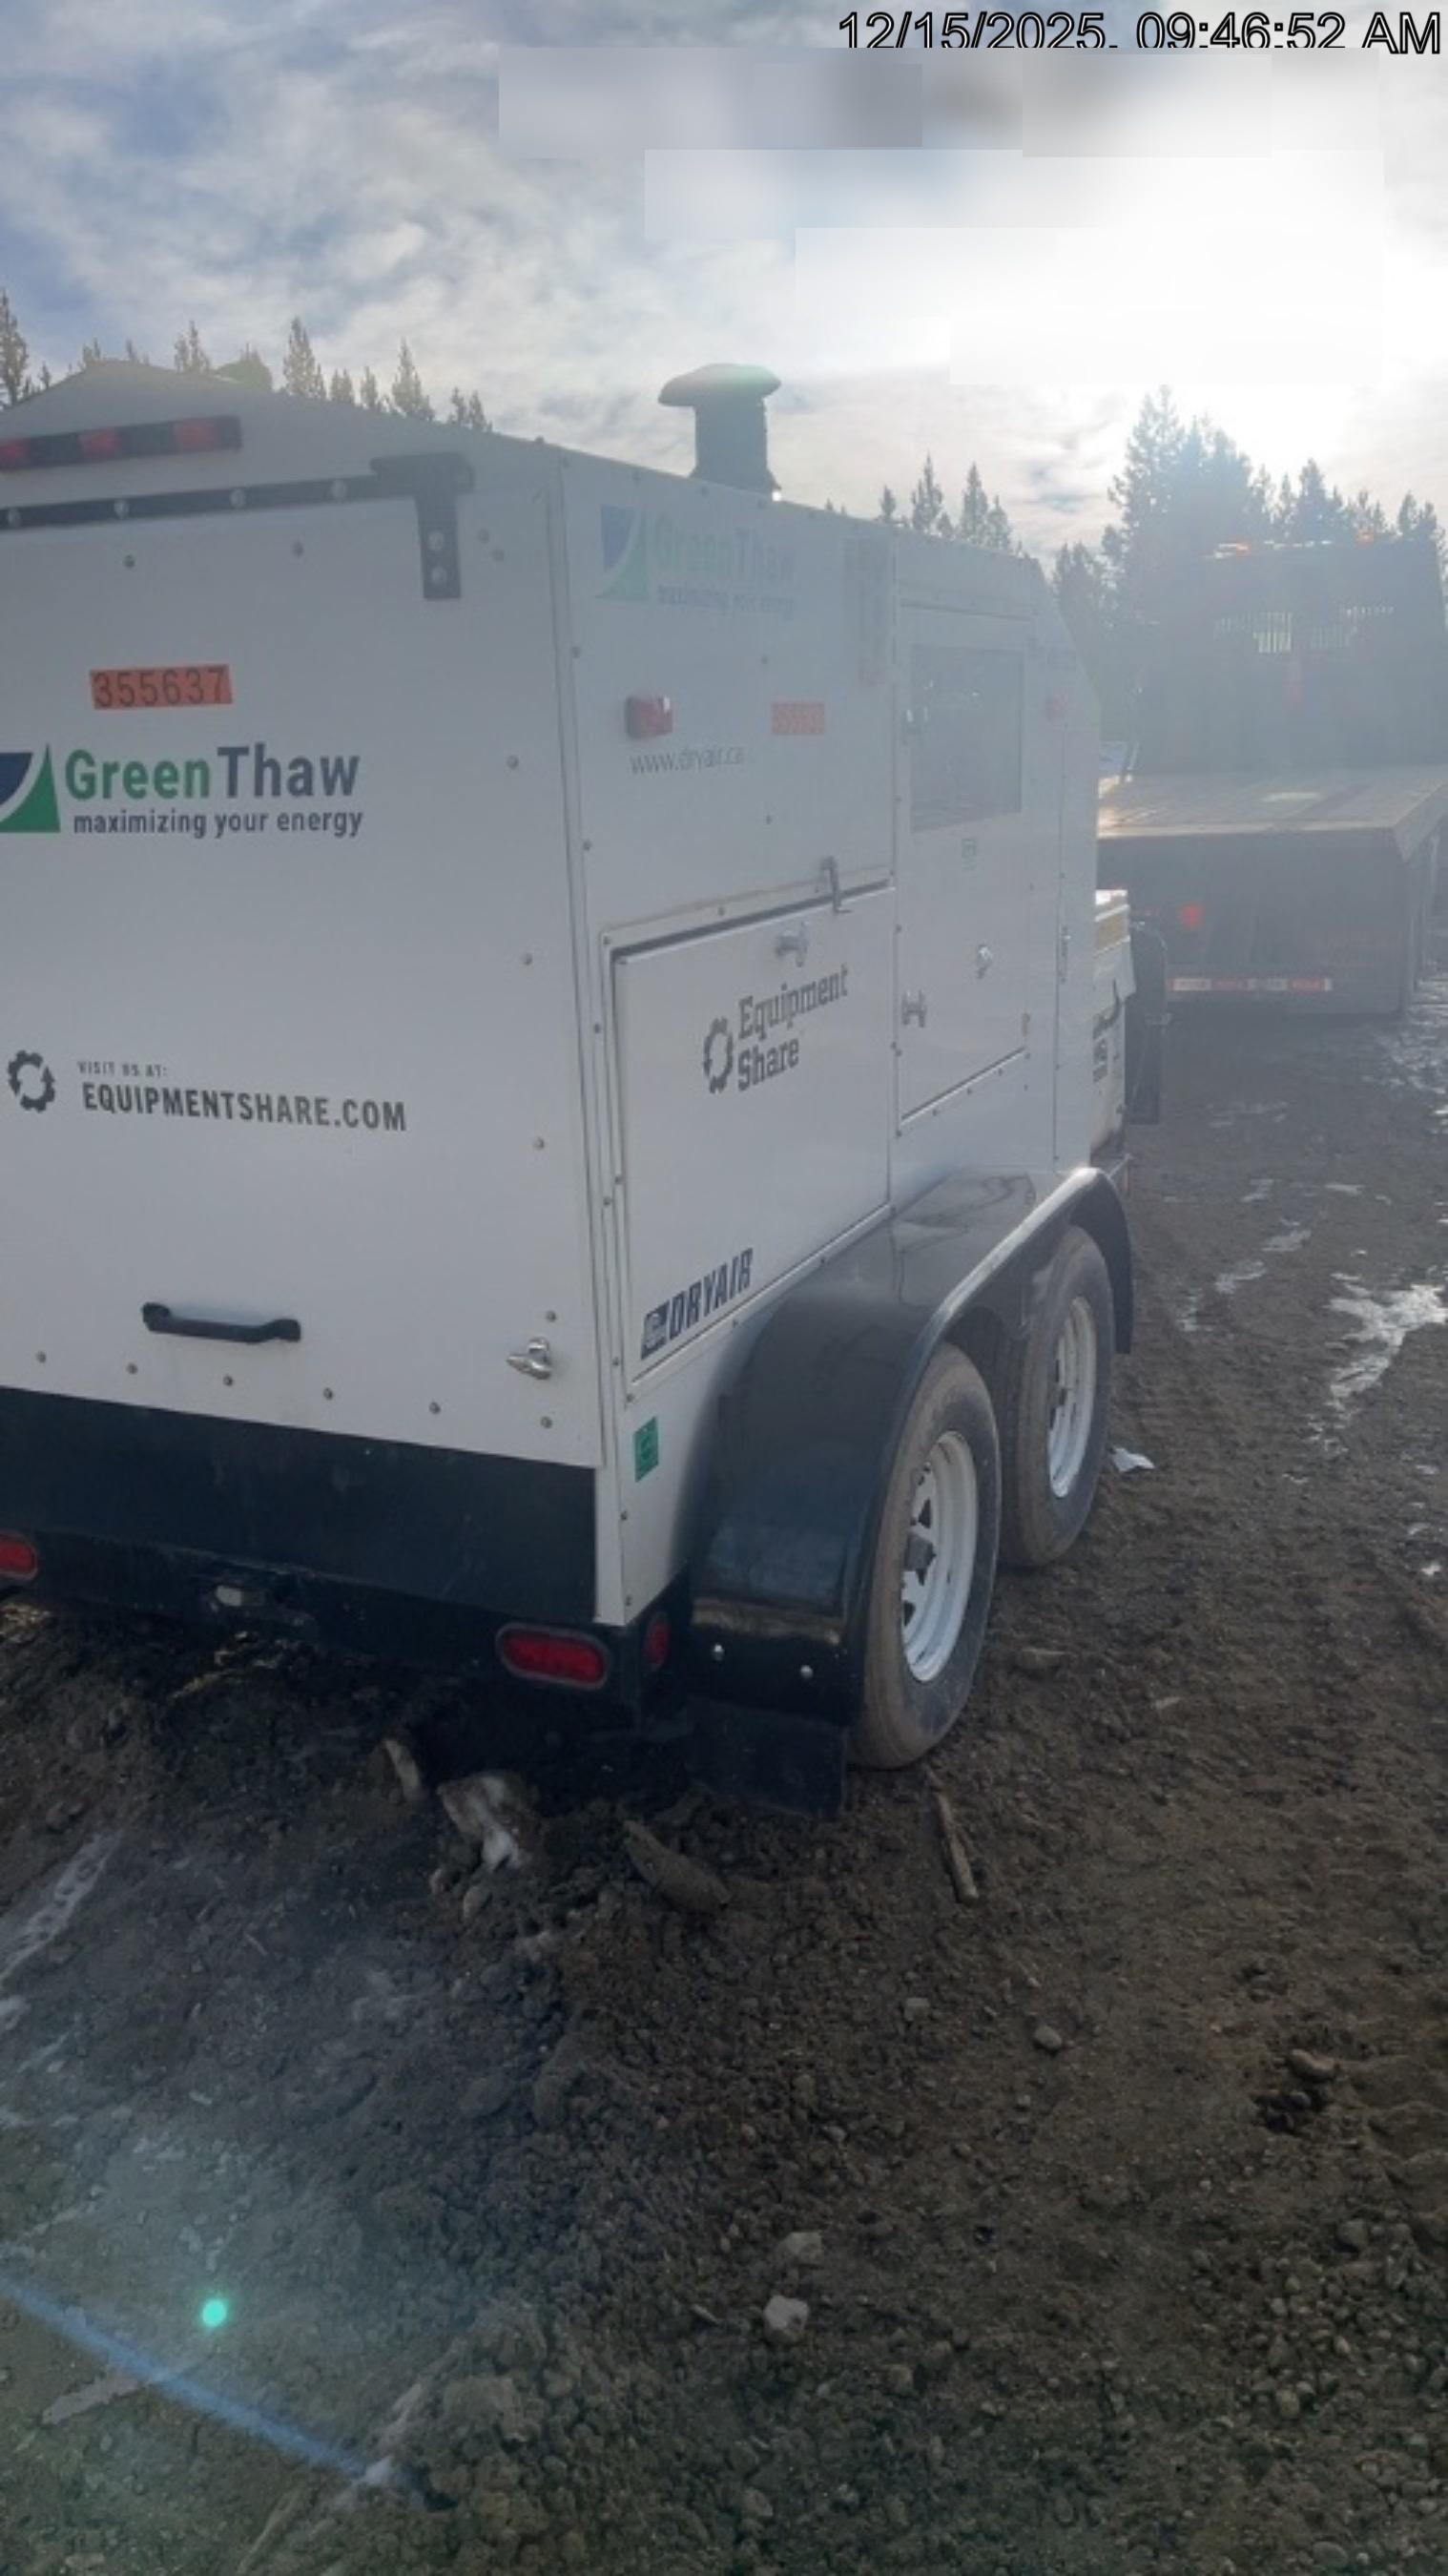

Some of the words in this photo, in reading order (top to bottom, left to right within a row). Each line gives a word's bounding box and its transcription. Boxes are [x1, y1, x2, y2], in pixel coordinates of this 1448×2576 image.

[94, 668, 228, 708] 355637
[73, 808, 207, 839] maximizing
[214, 811, 269, 838] your
[276, 811, 363, 838] energy
[737, 963, 848, 1041] Equipment
[78, 1060, 115, 1076] VISIT
[146, 1064, 168, 1078] AT:
[737, 1037, 800, 1092] Share
[82, 1081, 407, 1132] EQUIPMENTSHARE.COM
[670, 1247, 753, 1340] DRYAIR
